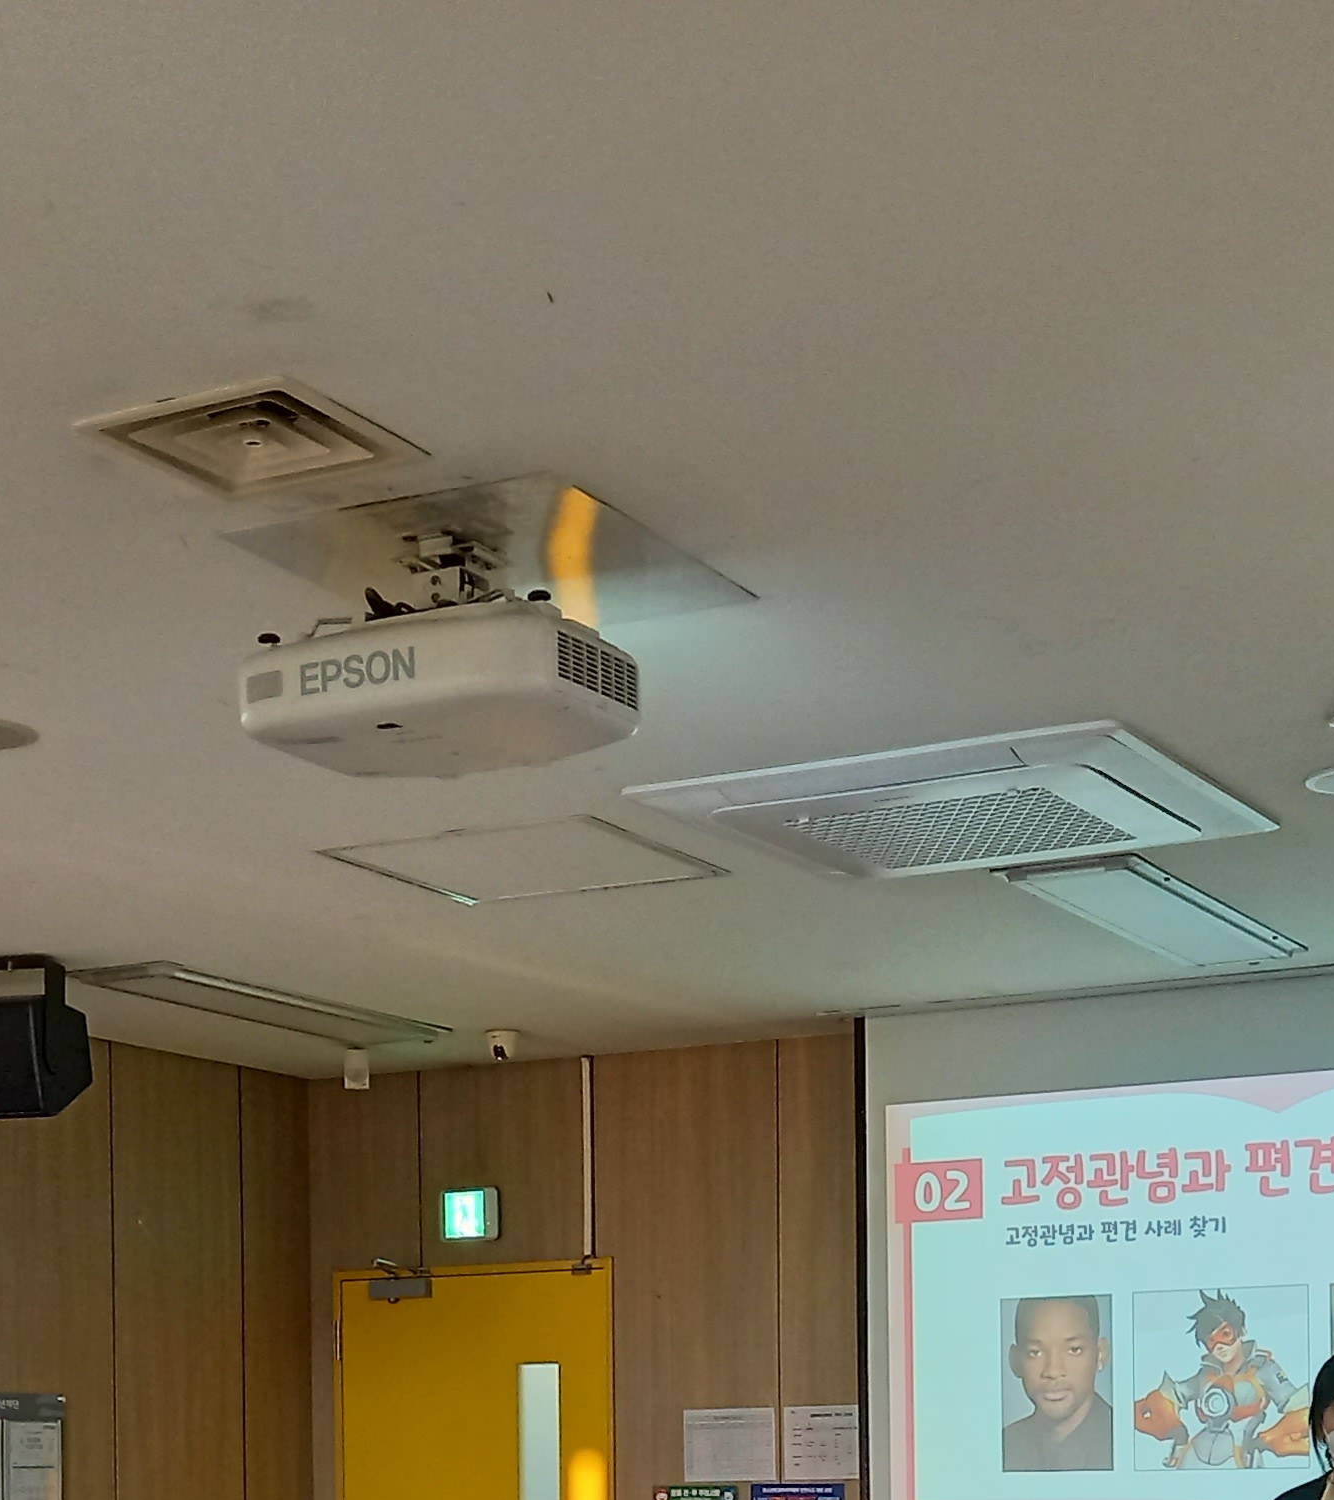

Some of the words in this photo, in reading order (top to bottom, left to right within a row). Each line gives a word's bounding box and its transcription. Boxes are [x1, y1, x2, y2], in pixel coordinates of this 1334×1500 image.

[299, 646, 416, 697] EPSON
[913, 1169, 972, 1213] 02
[1000, 1147, 1231, 1211] 고정관념과
[1005, 1220, 1095, 1248] 고정관념과
[1100, 1219, 1138, 1242] 편견
[1144, 1217, 1182, 1239] 사례
[1188, 1215, 1228, 1238] 찾기
